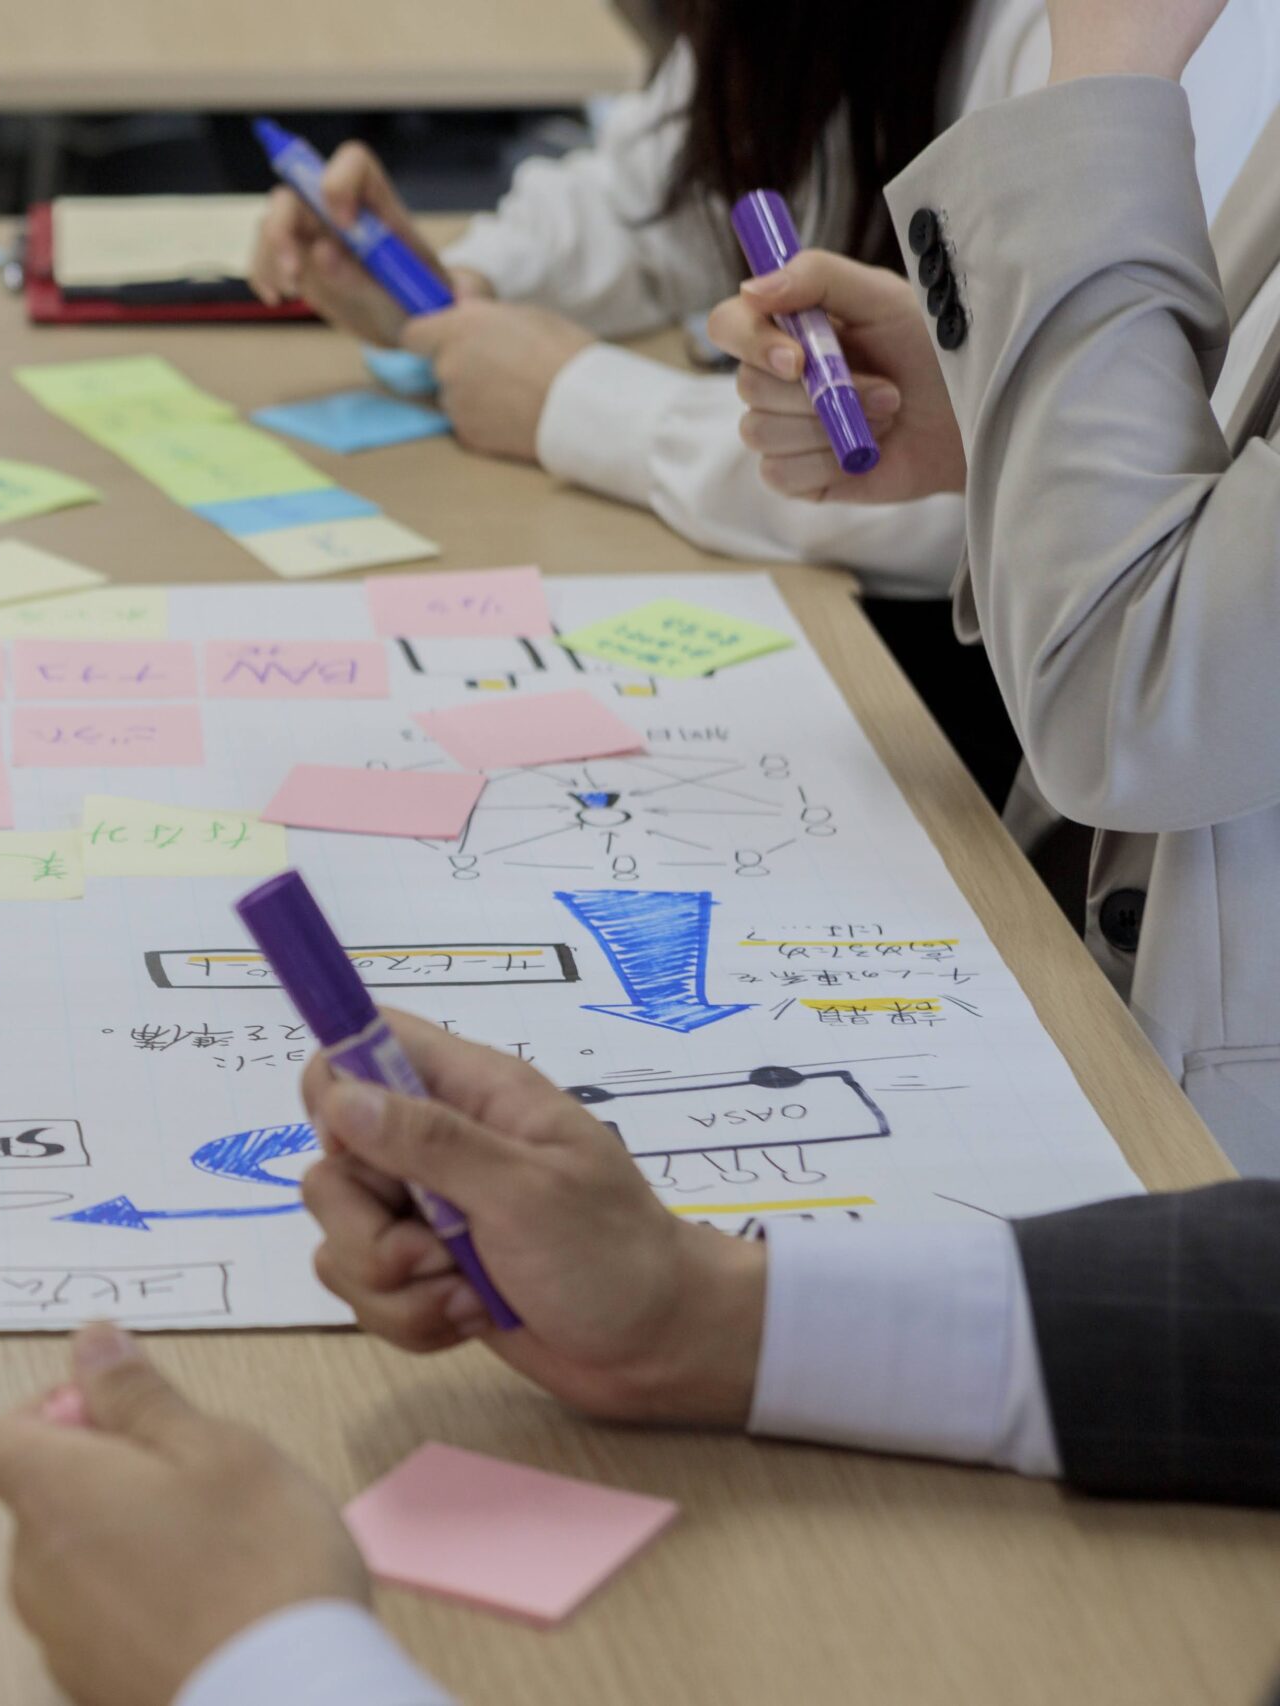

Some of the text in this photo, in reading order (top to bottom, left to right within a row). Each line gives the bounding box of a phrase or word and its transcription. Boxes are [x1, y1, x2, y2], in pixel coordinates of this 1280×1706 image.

[84, 820, 251, 850] ななみ
[777, 941, 955, 962] 高めるため
[807, 1001, 947, 1028] 課題
[687, 1103, 808, 1128] OASA
